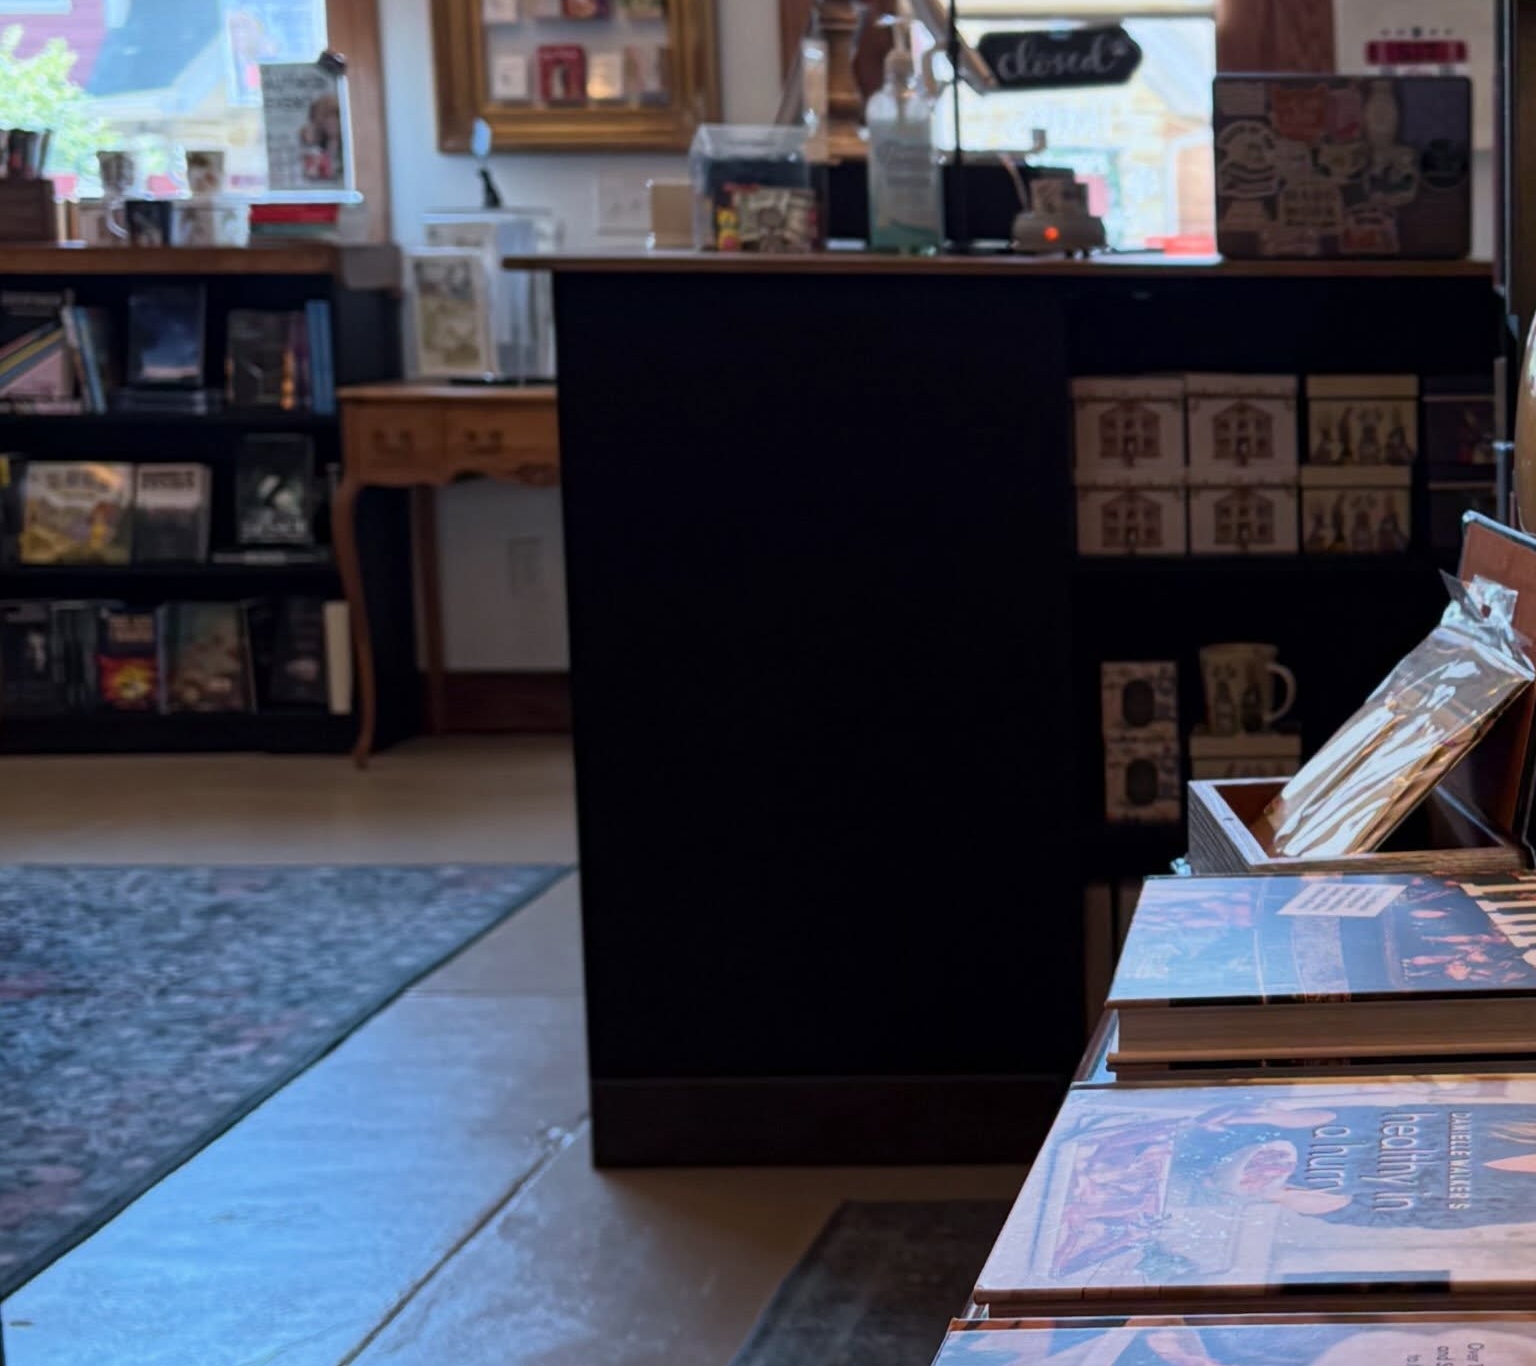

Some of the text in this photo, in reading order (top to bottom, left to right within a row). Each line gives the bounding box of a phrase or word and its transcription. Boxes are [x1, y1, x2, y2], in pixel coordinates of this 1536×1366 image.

[997, 34, 1118, 81] closed
[1449, 1111, 1473, 1156] DANIELLE
[1288, 1124, 1374, 1193] a hurry
[1359, 1110, 1440, 1213] healthy in
[1436, 1346, 1456, 1361] and
[1466, 1343, 1485, 1363] Over
